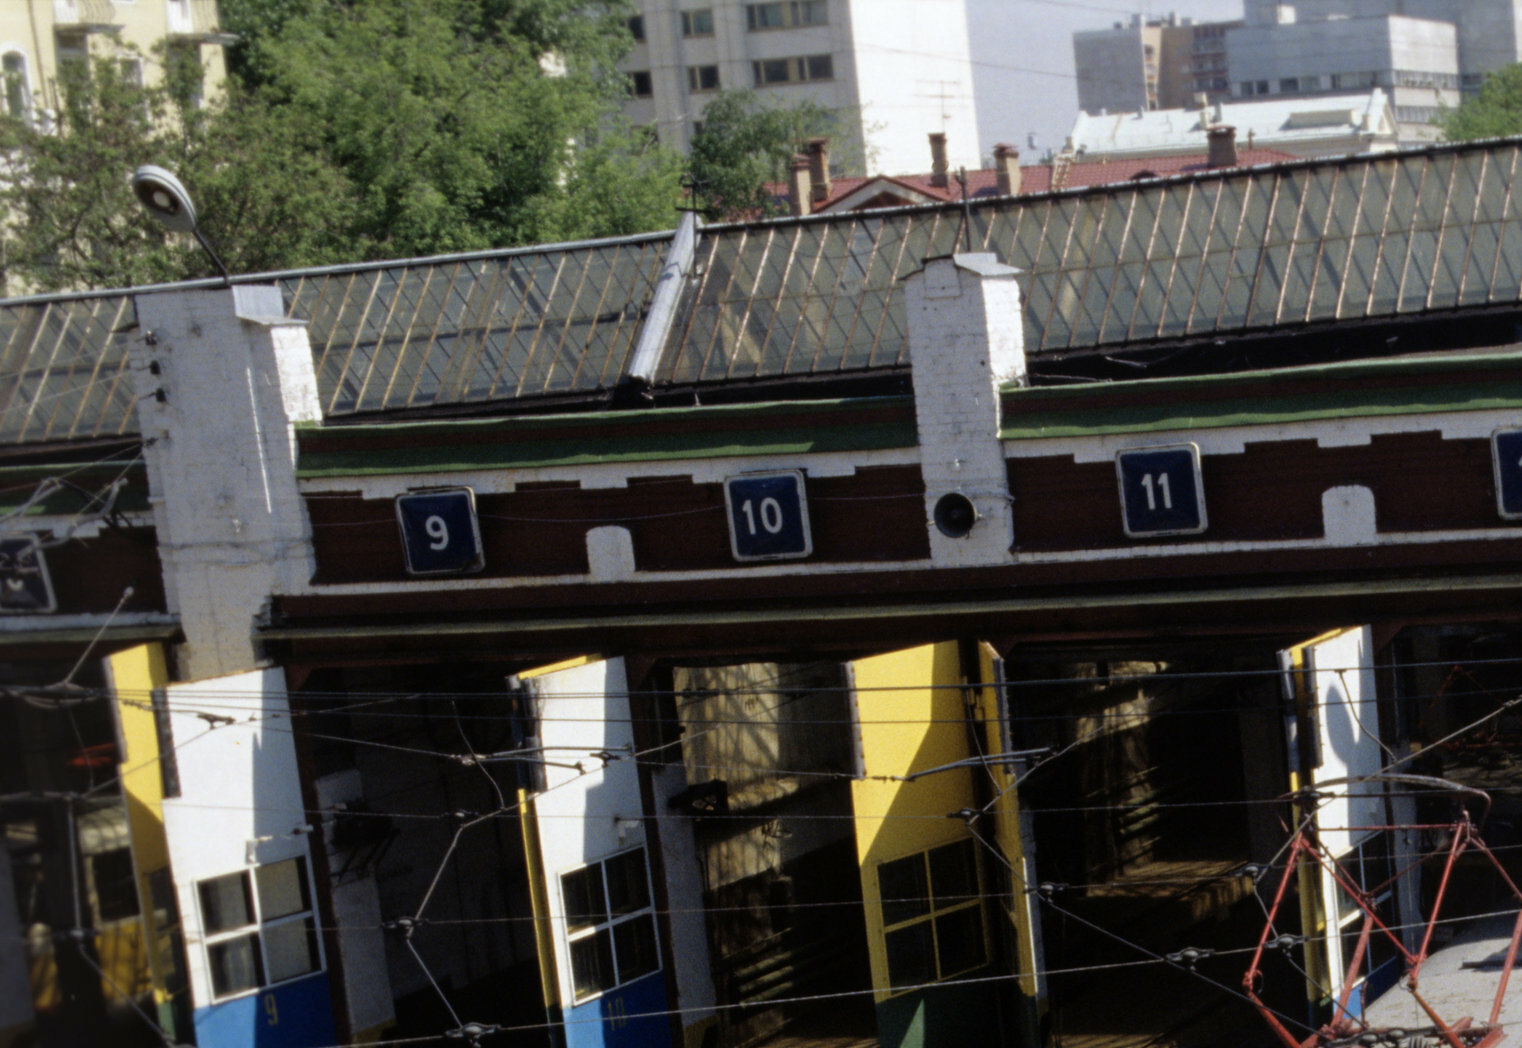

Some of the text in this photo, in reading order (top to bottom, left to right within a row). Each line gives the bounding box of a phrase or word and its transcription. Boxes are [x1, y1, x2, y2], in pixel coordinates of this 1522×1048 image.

[1140, 472, 1172, 510] 11
[425, 514, 450, 551] 9
[741, 496, 783, 535] 10
[264, 993, 279, 1027] 9
